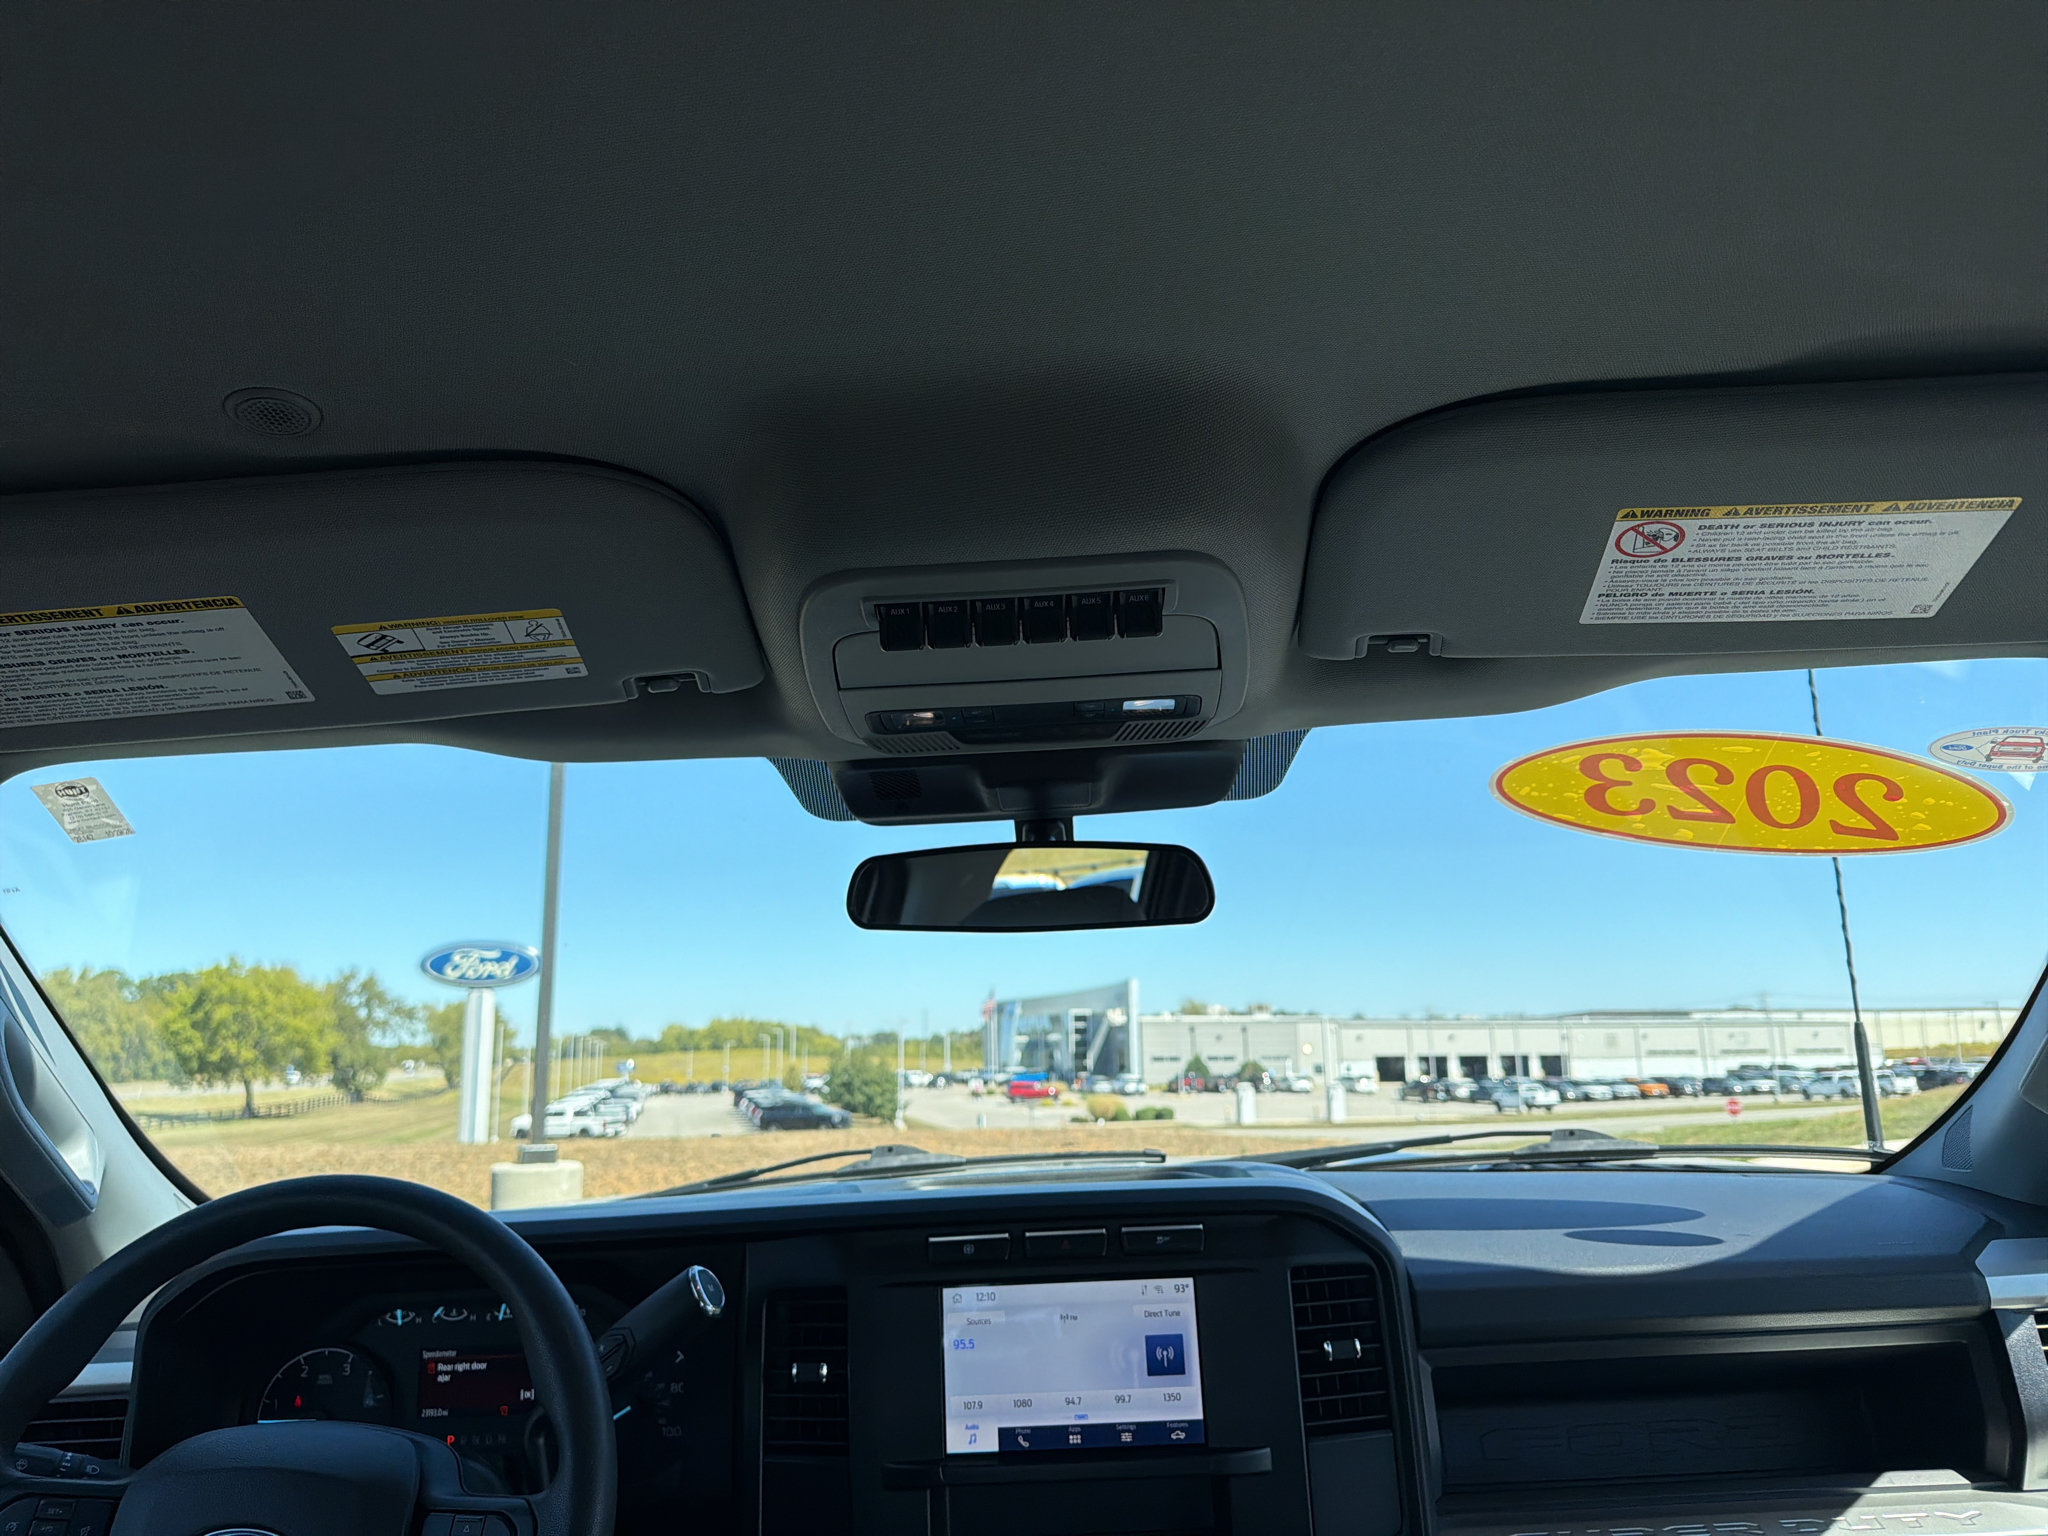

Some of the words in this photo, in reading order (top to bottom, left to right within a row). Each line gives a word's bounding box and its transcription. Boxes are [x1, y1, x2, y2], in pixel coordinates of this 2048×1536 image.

[1743, 503, 1874, 516] AVERTISSEMENT
[1905, 499, 2015, 511] ADVERTENCIA
[1640, 508, 1711, 521] WARNING
[1129, 595, 1143, 603] AUX
[1144, 594, 1149, 602] 6
[134, 597, 239, 613] ADVERTENCIA
[938, 606, 953, 614] AUX
[1033, 601, 1048, 609] AUX
[890, 608, 906, 616] AUX
[14, 627, 70, 636] SERIOUS
[72, 622, 117, 632] INJURY
[146, 618, 184, 626] occur.
[47, 656, 97, 665] GRAVES
[116, 649, 195, 659] MORTELLES.
[20, 691, 73, 701] MUERTE
[83, 687, 120, 695] SERIA
[122, 684, 168, 693] LESIÓN.
[443, 948, 519, 980] Ford
[1174, 1284, 1190, 1293] 93°
[976, 1292, 996, 1302] 12:10
[1144, 1310, 1163, 1318] Direct
[1165, 1309, 1181, 1317] Tune
[966, 1318, 992, 1326] Sources
[953, 1339, 975, 1350] 95.5
[300, 1366, 309, 1377] 2
[342, 1364, 351, 1375] 3
[437, 1363, 454, 1372] Rear
[454, 1362, 471, 1372] right
[471, 1361, 487, 1370] door
[437, 1373, 451, 1383] ajar
[1065, 1397, 1082, 1406] 94.7
[1114, 1395, 1132, 1404] 99.7
[1163, 1393, 1181, 1402] 1350
[963, 1401, 983, 1410] 107.9
[1013, 1399, 1032, 1408] 1080
[447, 1435, 455, 1445] P
[1779, 1510, 1983, 1535] DUTY
